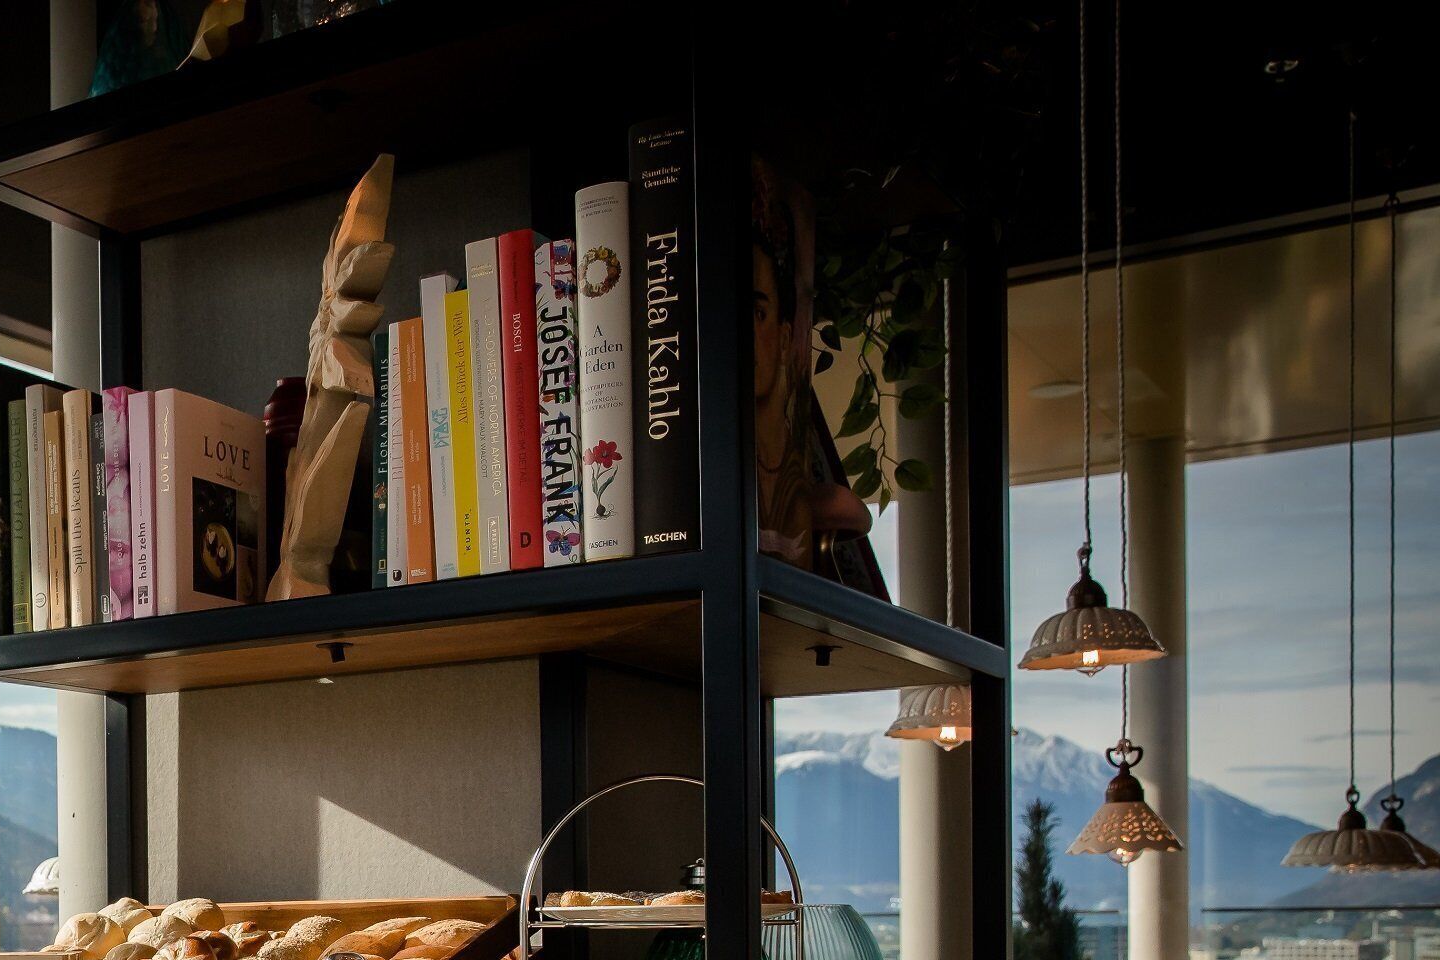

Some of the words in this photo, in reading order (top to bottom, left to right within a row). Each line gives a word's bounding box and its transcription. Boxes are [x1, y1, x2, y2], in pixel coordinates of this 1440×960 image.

[646, 227, 679, 329] Frida
[452, 311, 463, 337] Welt
[512, 313, 522, 353] BOSCH
[593, 324, 604, 338] A
[454, 339, 465, 358] der
[539, 306, 571, 404] JOSEF
[455, 361, 467, 394] Glück
[585, 358, 616, 375] Eden
[379, 358, 389, 426] MIRABILIS
[648, 331, 680, 440] Kahlo
[457, 396, 469, 424] Alles
[203, 434, 250, 471] LOVE
[377, 431, 388, 474] FLORA
[479, 442, 488, 479] WALCOTT
[161, 451, 170, 492] LOVE
[490, 447, 502, 496] AMERICA
[543, 417, 574, 525] FRANK
[70, 469, 81, 513] Beans
[71, 516, 82, 540] the
[137, 522, 147, 550] zehn
[588, 539, 618, 550] TASCHEN
[643, 531, 688, 545] TASCHEN
[71, 544, 88, 574] Spill
[138, 553, 148, 579] halb
